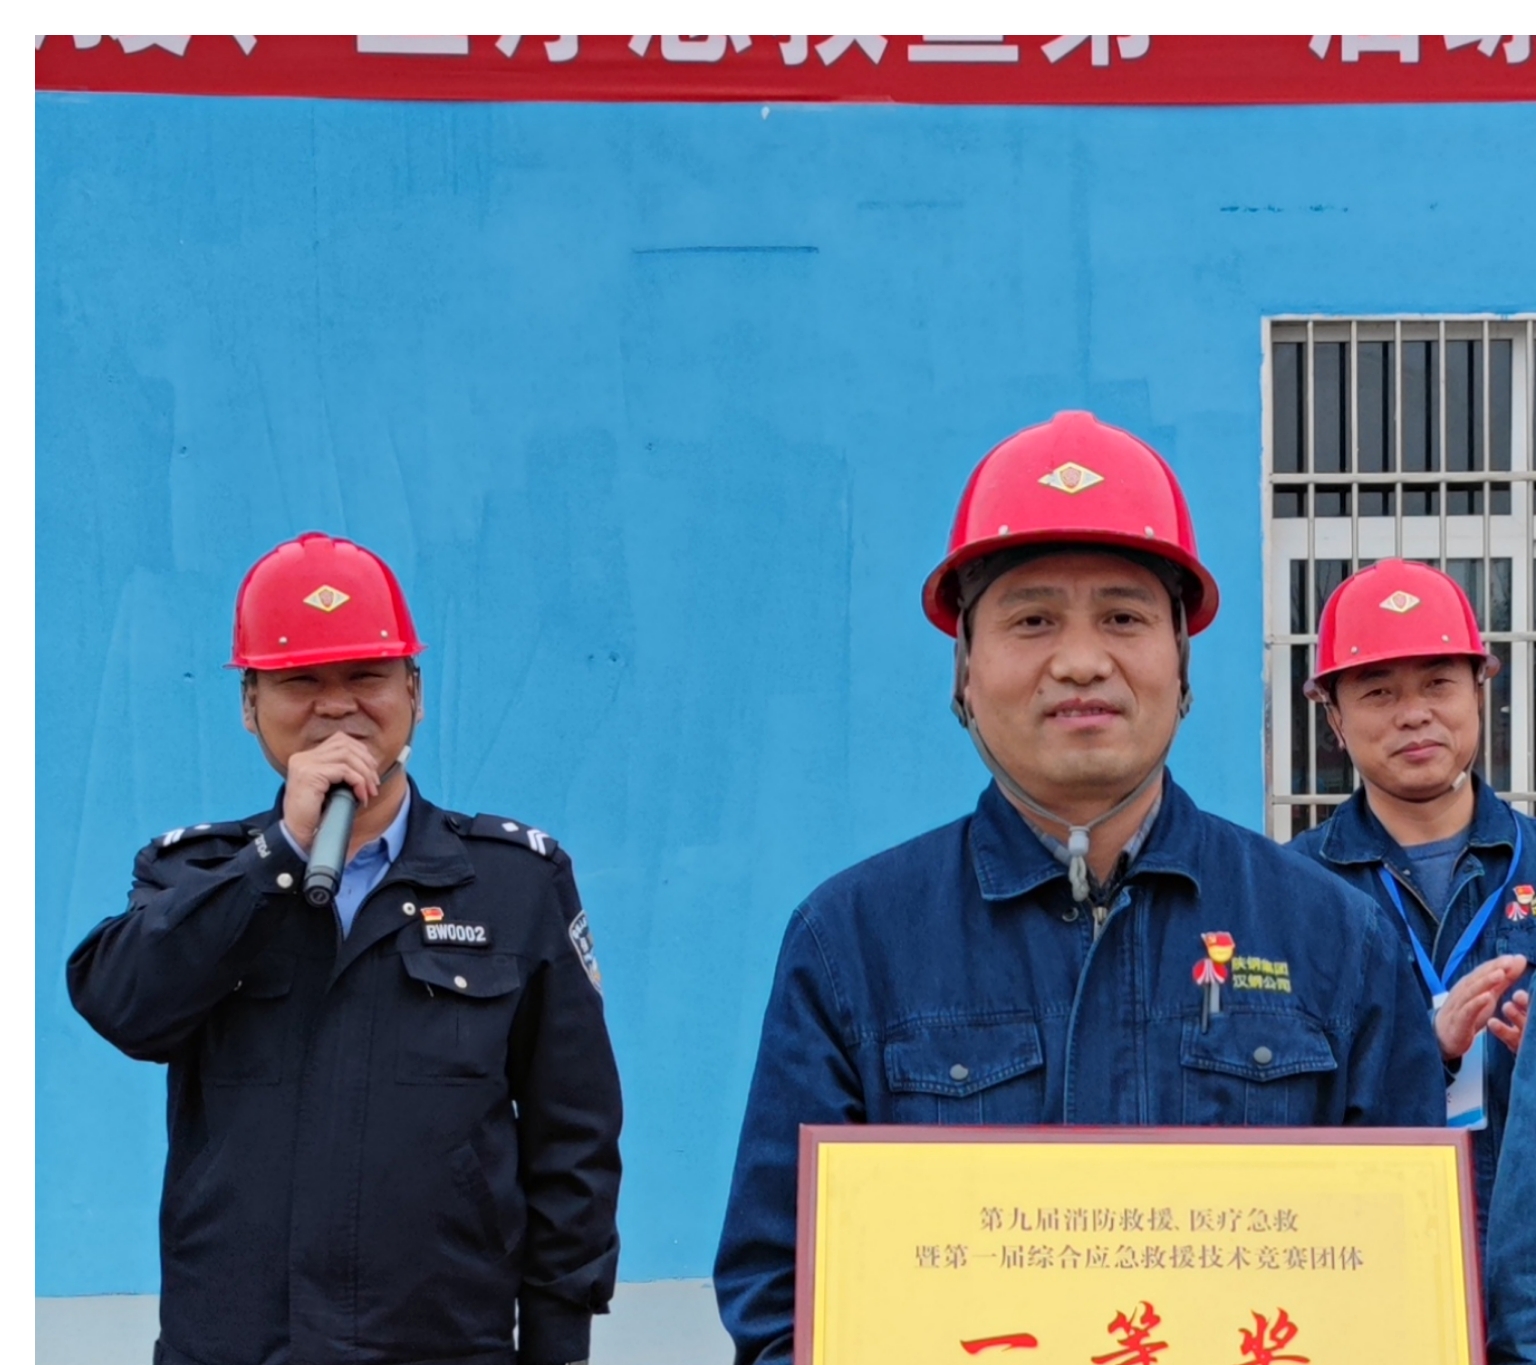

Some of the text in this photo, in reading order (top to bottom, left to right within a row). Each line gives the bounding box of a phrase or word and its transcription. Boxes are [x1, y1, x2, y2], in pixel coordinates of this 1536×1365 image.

[426, 924, 487, 943] BW0002
[978, 1205, 1300, 1234] 第九届消防救援、医疗急救
[914, 1243, 1365, 1272] 暨第一届综合应急救援技术竞赛团体
